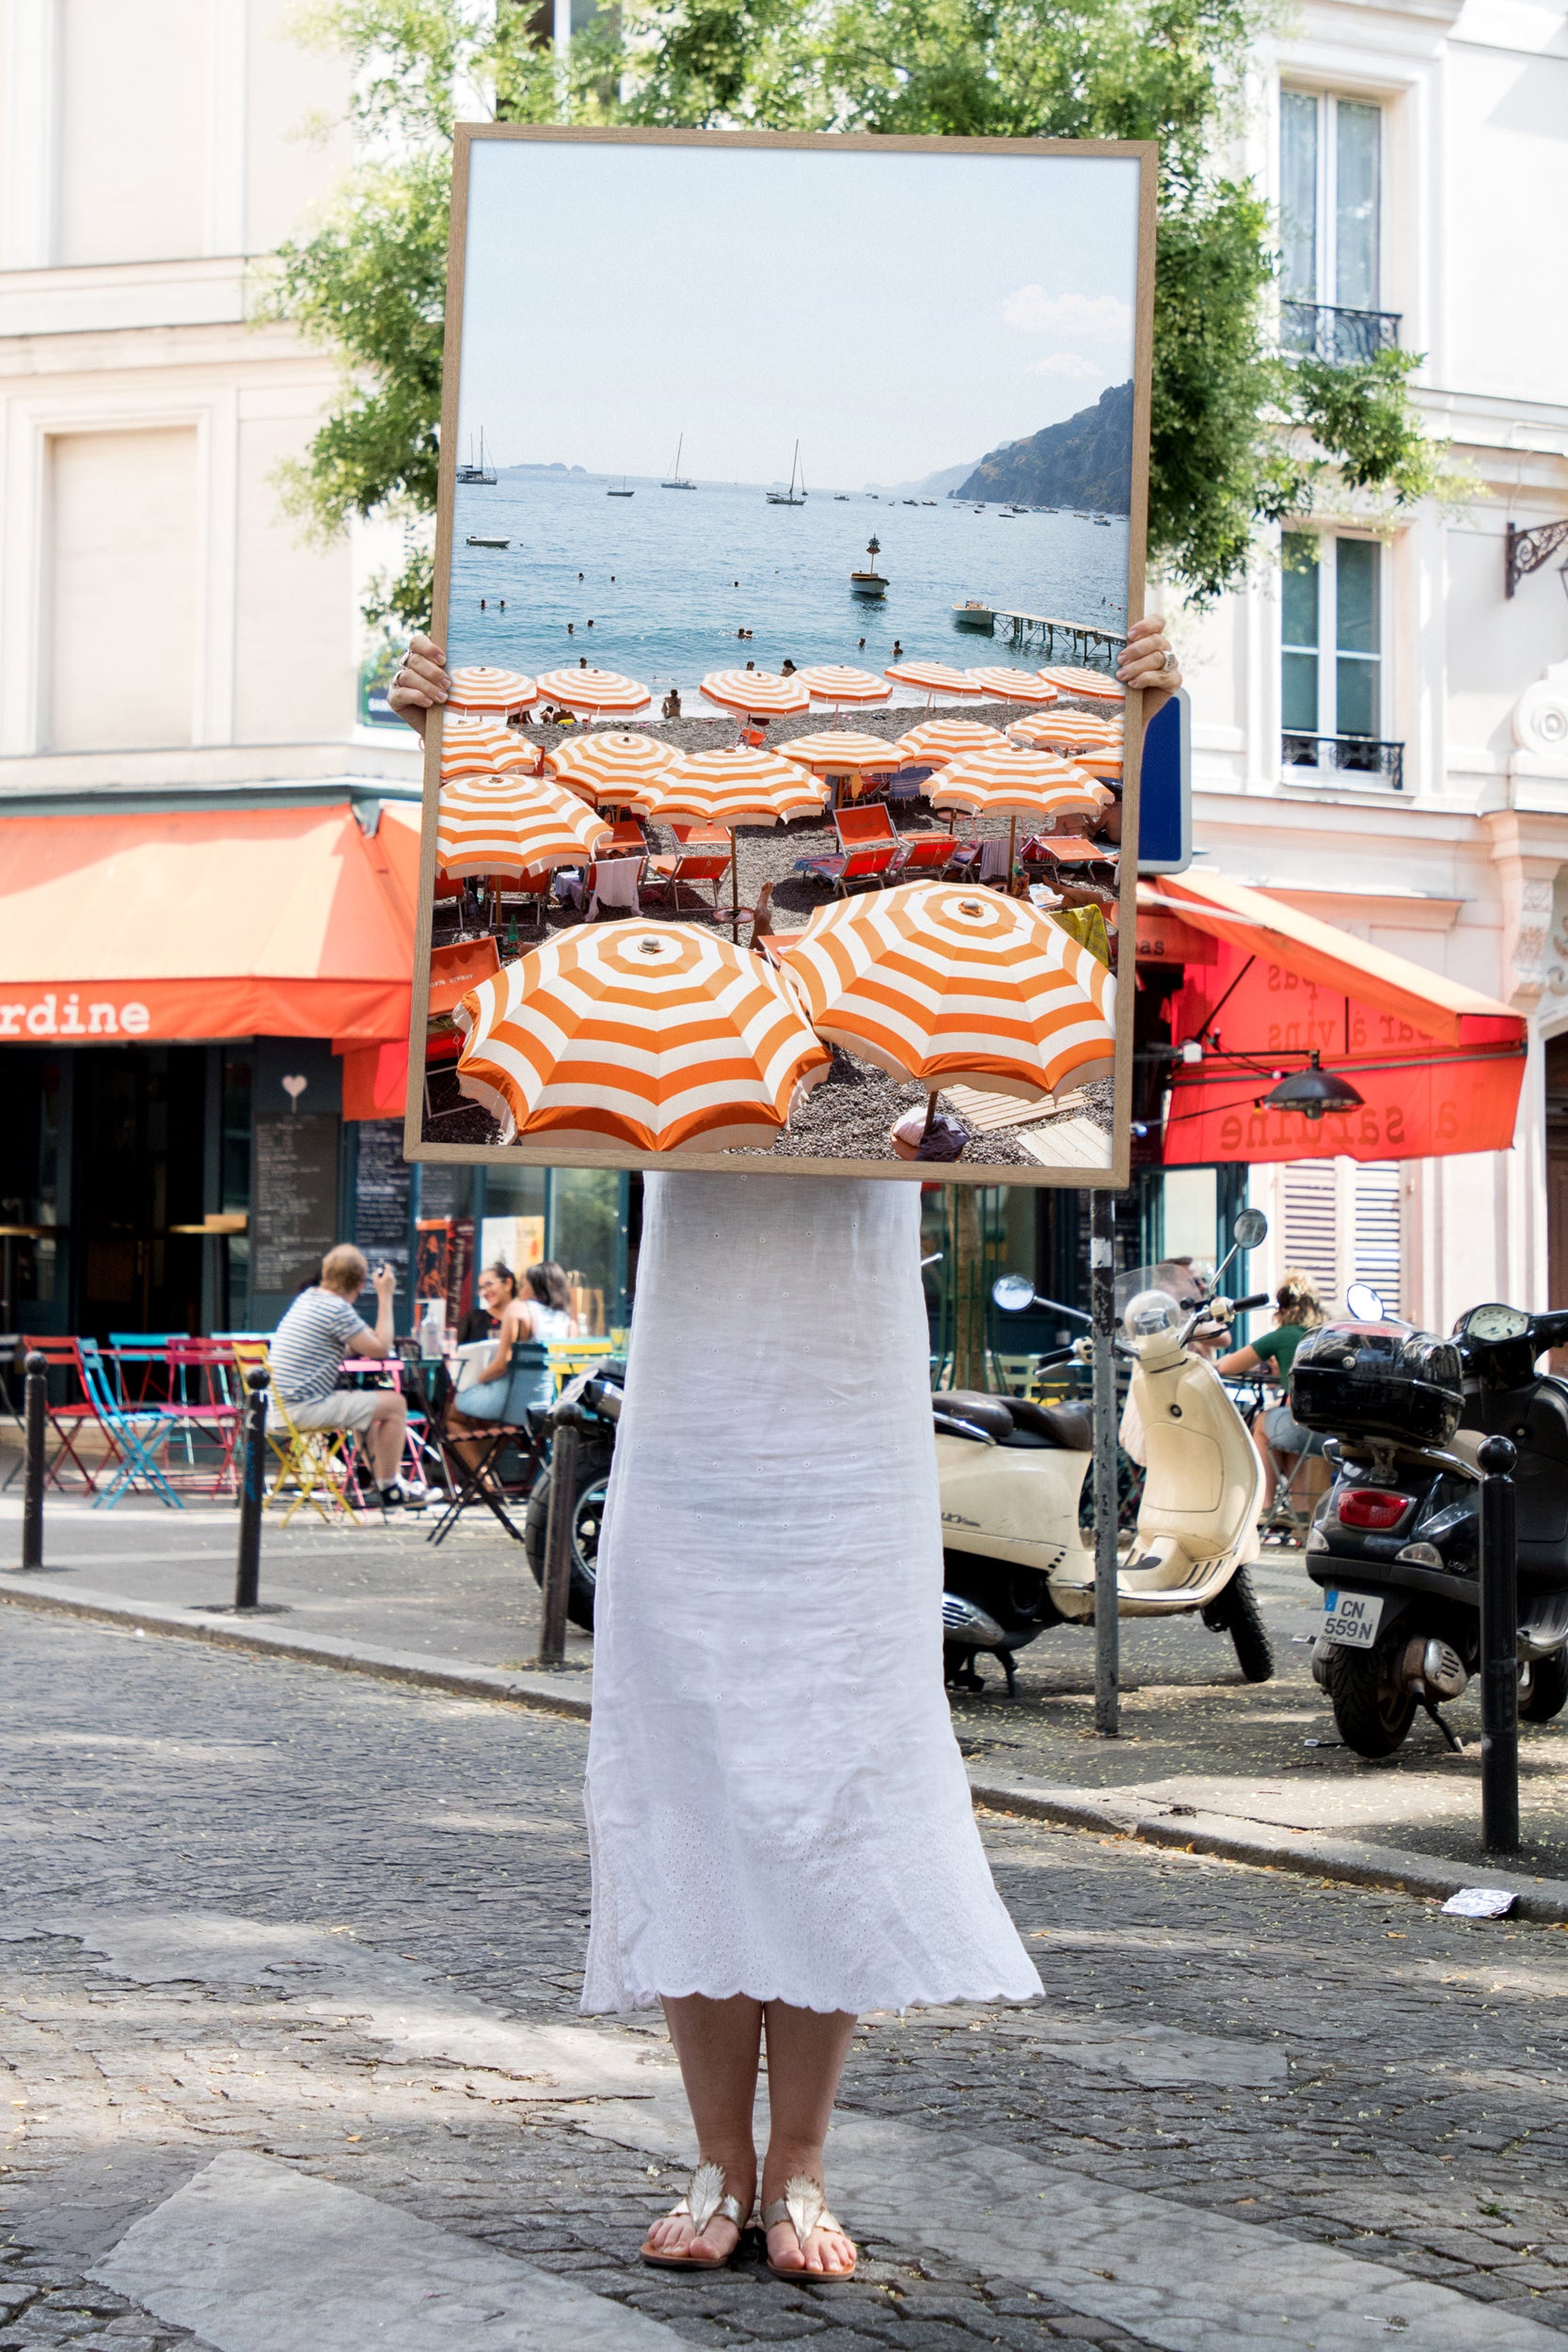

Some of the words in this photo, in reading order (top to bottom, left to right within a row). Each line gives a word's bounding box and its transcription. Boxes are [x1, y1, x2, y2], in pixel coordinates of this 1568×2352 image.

[1135, 940, 1165, 956] as
[0, 993, 150, 1035] rdine
[1340, 1600, 1365, 1619] CN
[1324, 1617, 1372, 1641] 559N
